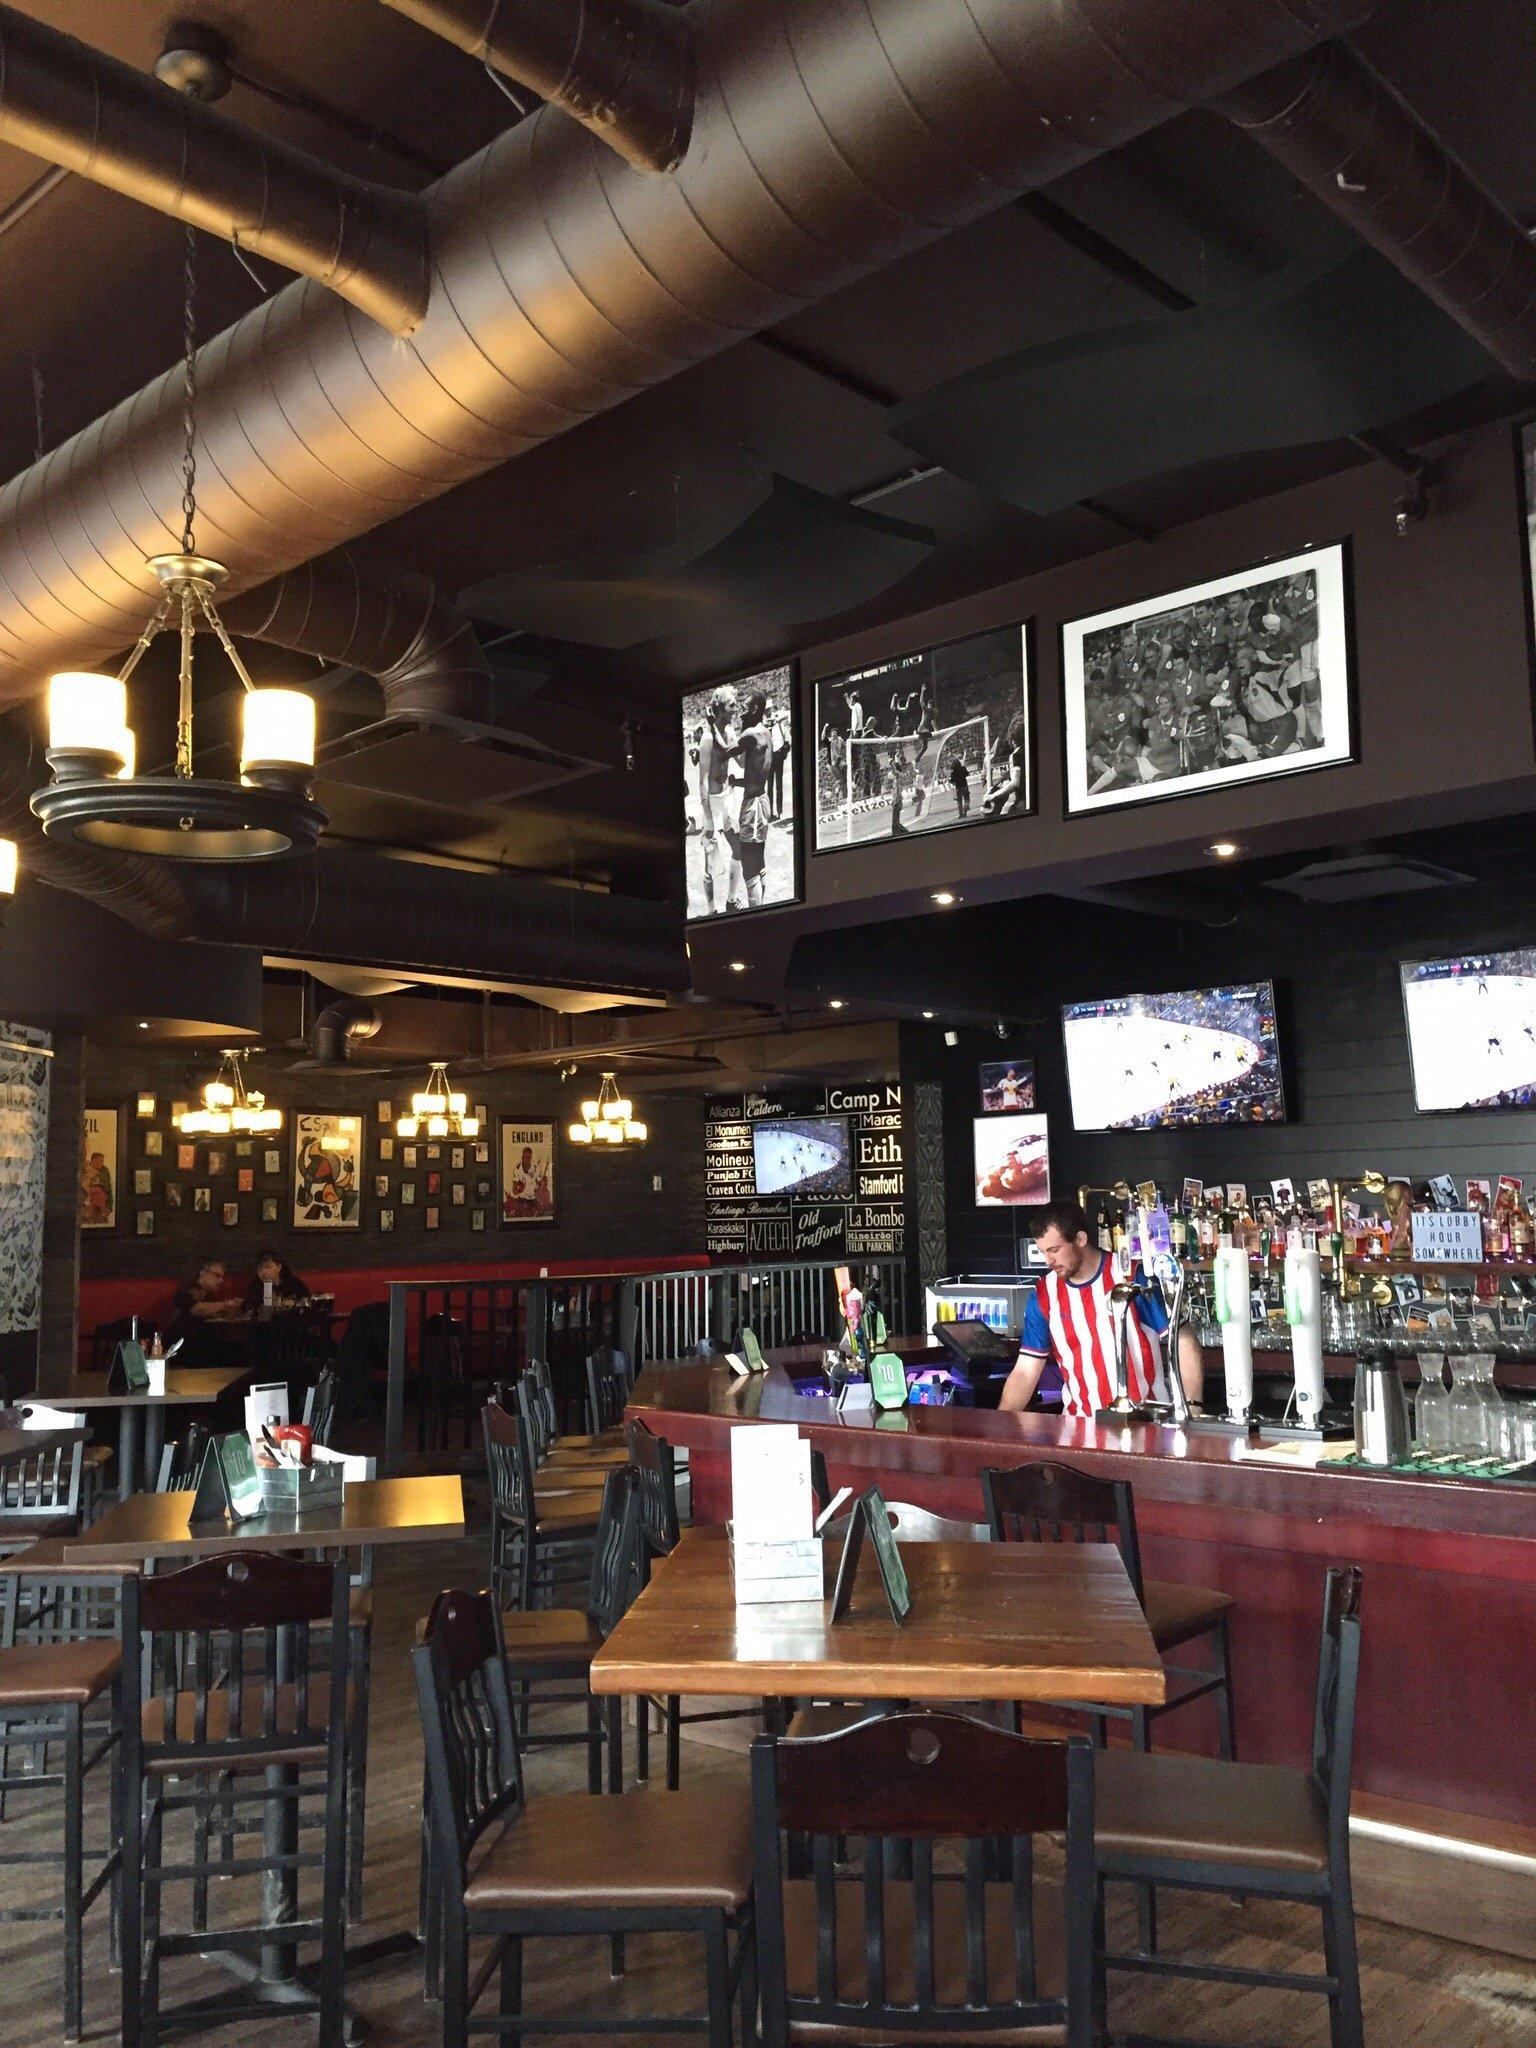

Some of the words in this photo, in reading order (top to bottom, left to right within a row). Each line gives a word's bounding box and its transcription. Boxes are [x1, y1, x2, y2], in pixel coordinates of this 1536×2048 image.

[830, 1090, 880, 1112] Camp
[863, 1114, 902, 1127] Marac
[512, 1131, 544, 1143] ENGLAND
[860, 1134, 902, 1164] Etih
[707, 1170, 740, 1181] Punjab
[706, 1183, 734, 1196] Craven
[735, 1182, 755, 1195] Cotta
[860, 1174, 898, 1195] Stamford
[708, 1203, 746, 1217] Santiago
[849, 1208, 862, 1227] La
[865, 1206, 904, 1227] Bombo
[798, 1208, 820, 1230] Old
[1416, 1216, 1435, 1228] ITS
[1439, 1215, 1477, 1227] LOBBY
[750, 1222, 790, 1250] AZTECA
[795, 1219, 843, 1250] Trafford
[1430, 1231, 1461, 1243] HOUR
[708, 1239, 745, 1253] Highbury
[866, 1240, 892, 1252] PARKEN
